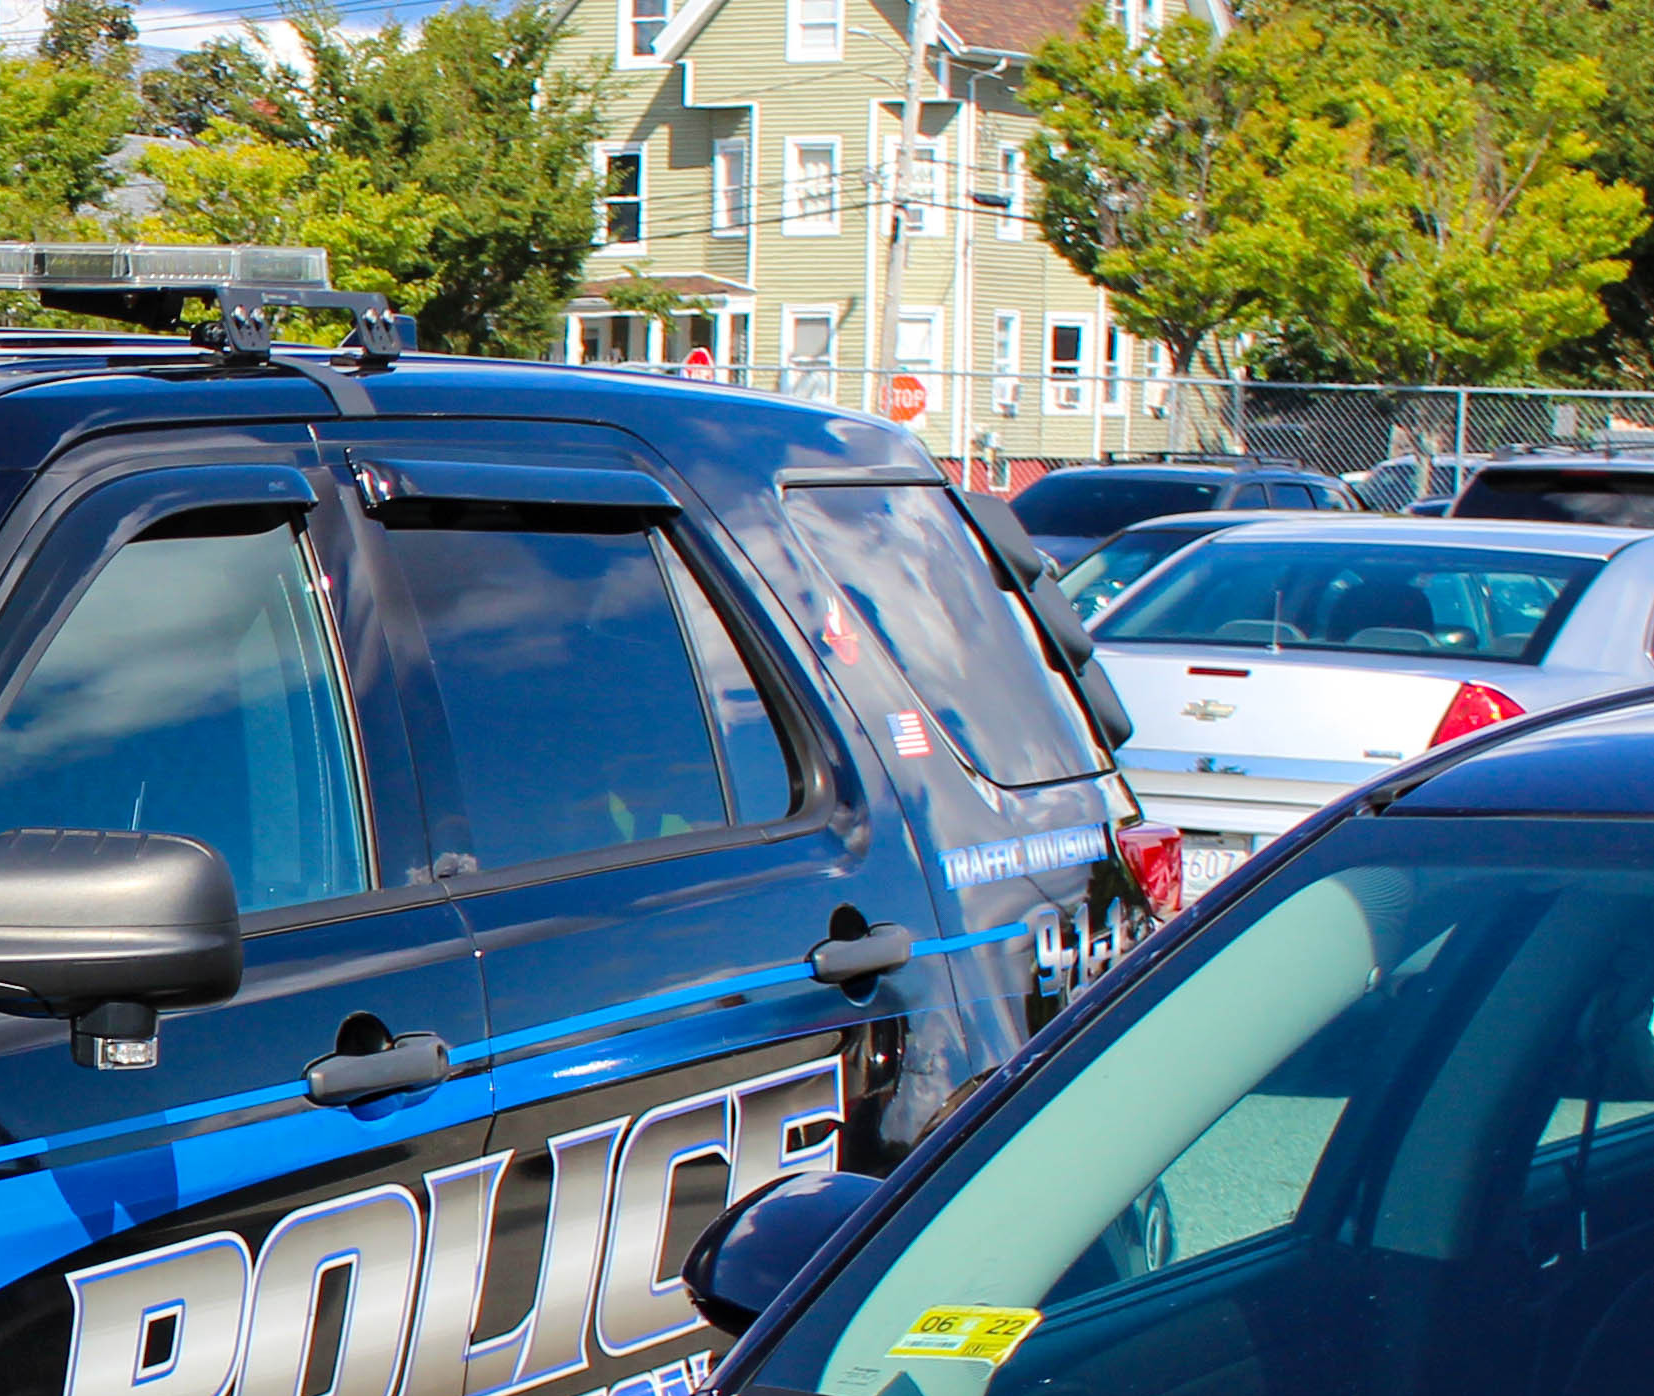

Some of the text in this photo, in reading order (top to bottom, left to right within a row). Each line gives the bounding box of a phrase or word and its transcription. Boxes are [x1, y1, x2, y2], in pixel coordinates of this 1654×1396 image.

[888, 388, 925, 408] TOP
[940, 824, 1108, 889] TRAFFIC DIVISION
[921, 1315, 1026, 1336] 06 22
